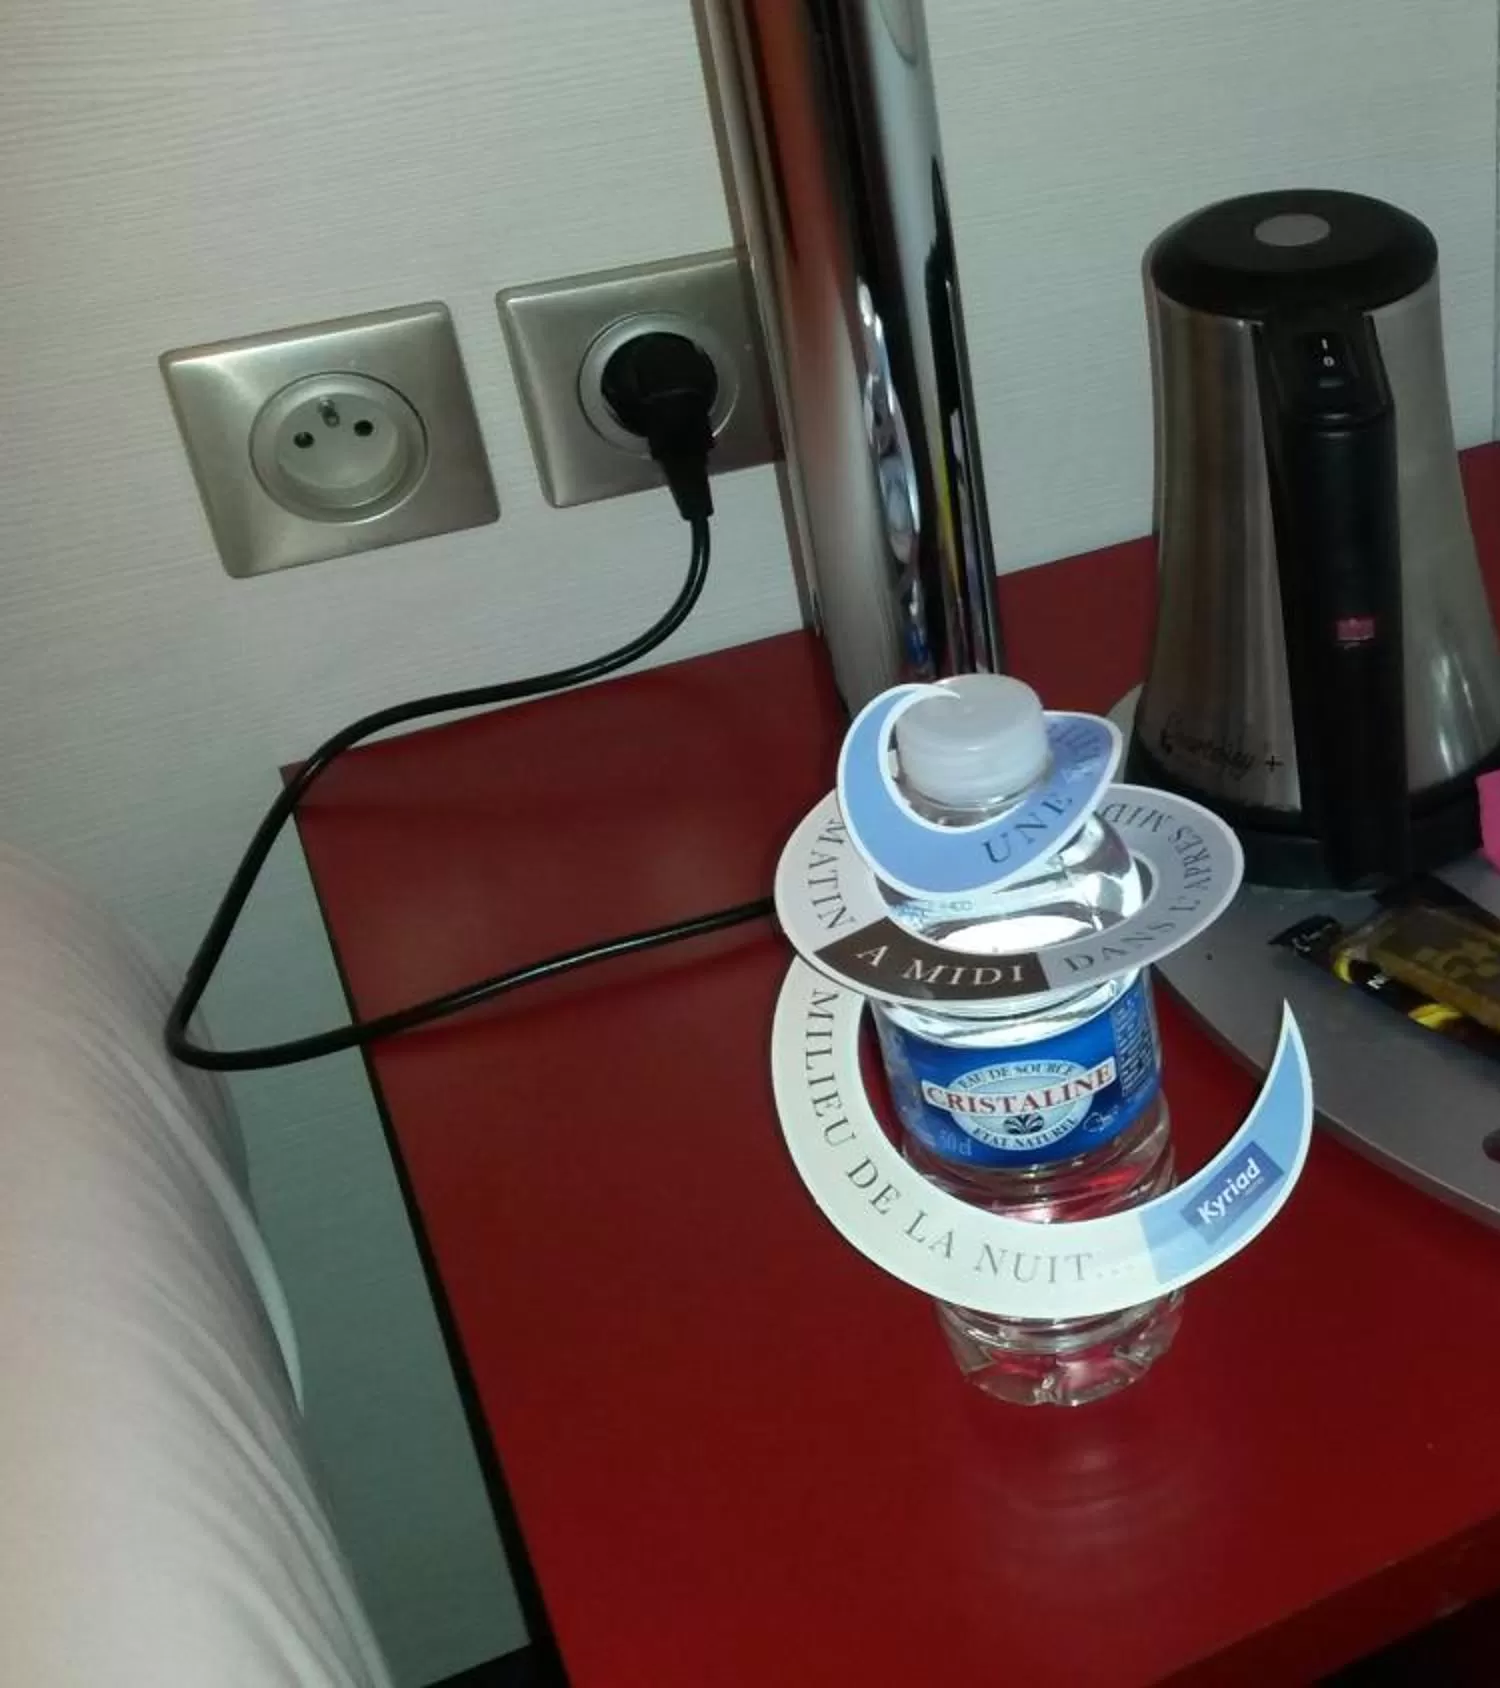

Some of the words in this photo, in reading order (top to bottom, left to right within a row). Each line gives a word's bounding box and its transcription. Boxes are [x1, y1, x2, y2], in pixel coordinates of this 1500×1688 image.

[982, 790, 1073, 864] UNE
[1102, 802, 1174, 834] MID
[807, 817, 857, 930] MATIN
[857, 945, 889, 967] A
[901, 958, 1026, 985] MIDI
[1063, 920, 1176, 972] DANS
[926, 1065, 1112, 1115] CRISTALINE
[988, 1067, 1008, 1081] DE
[805, 988, 856, 1148] MILIEU
[846, 1158, 902, 1216] DE
[904, 1210, 955, 1259] LA
[1195, 1156, 1262, 1225] Kyriad
